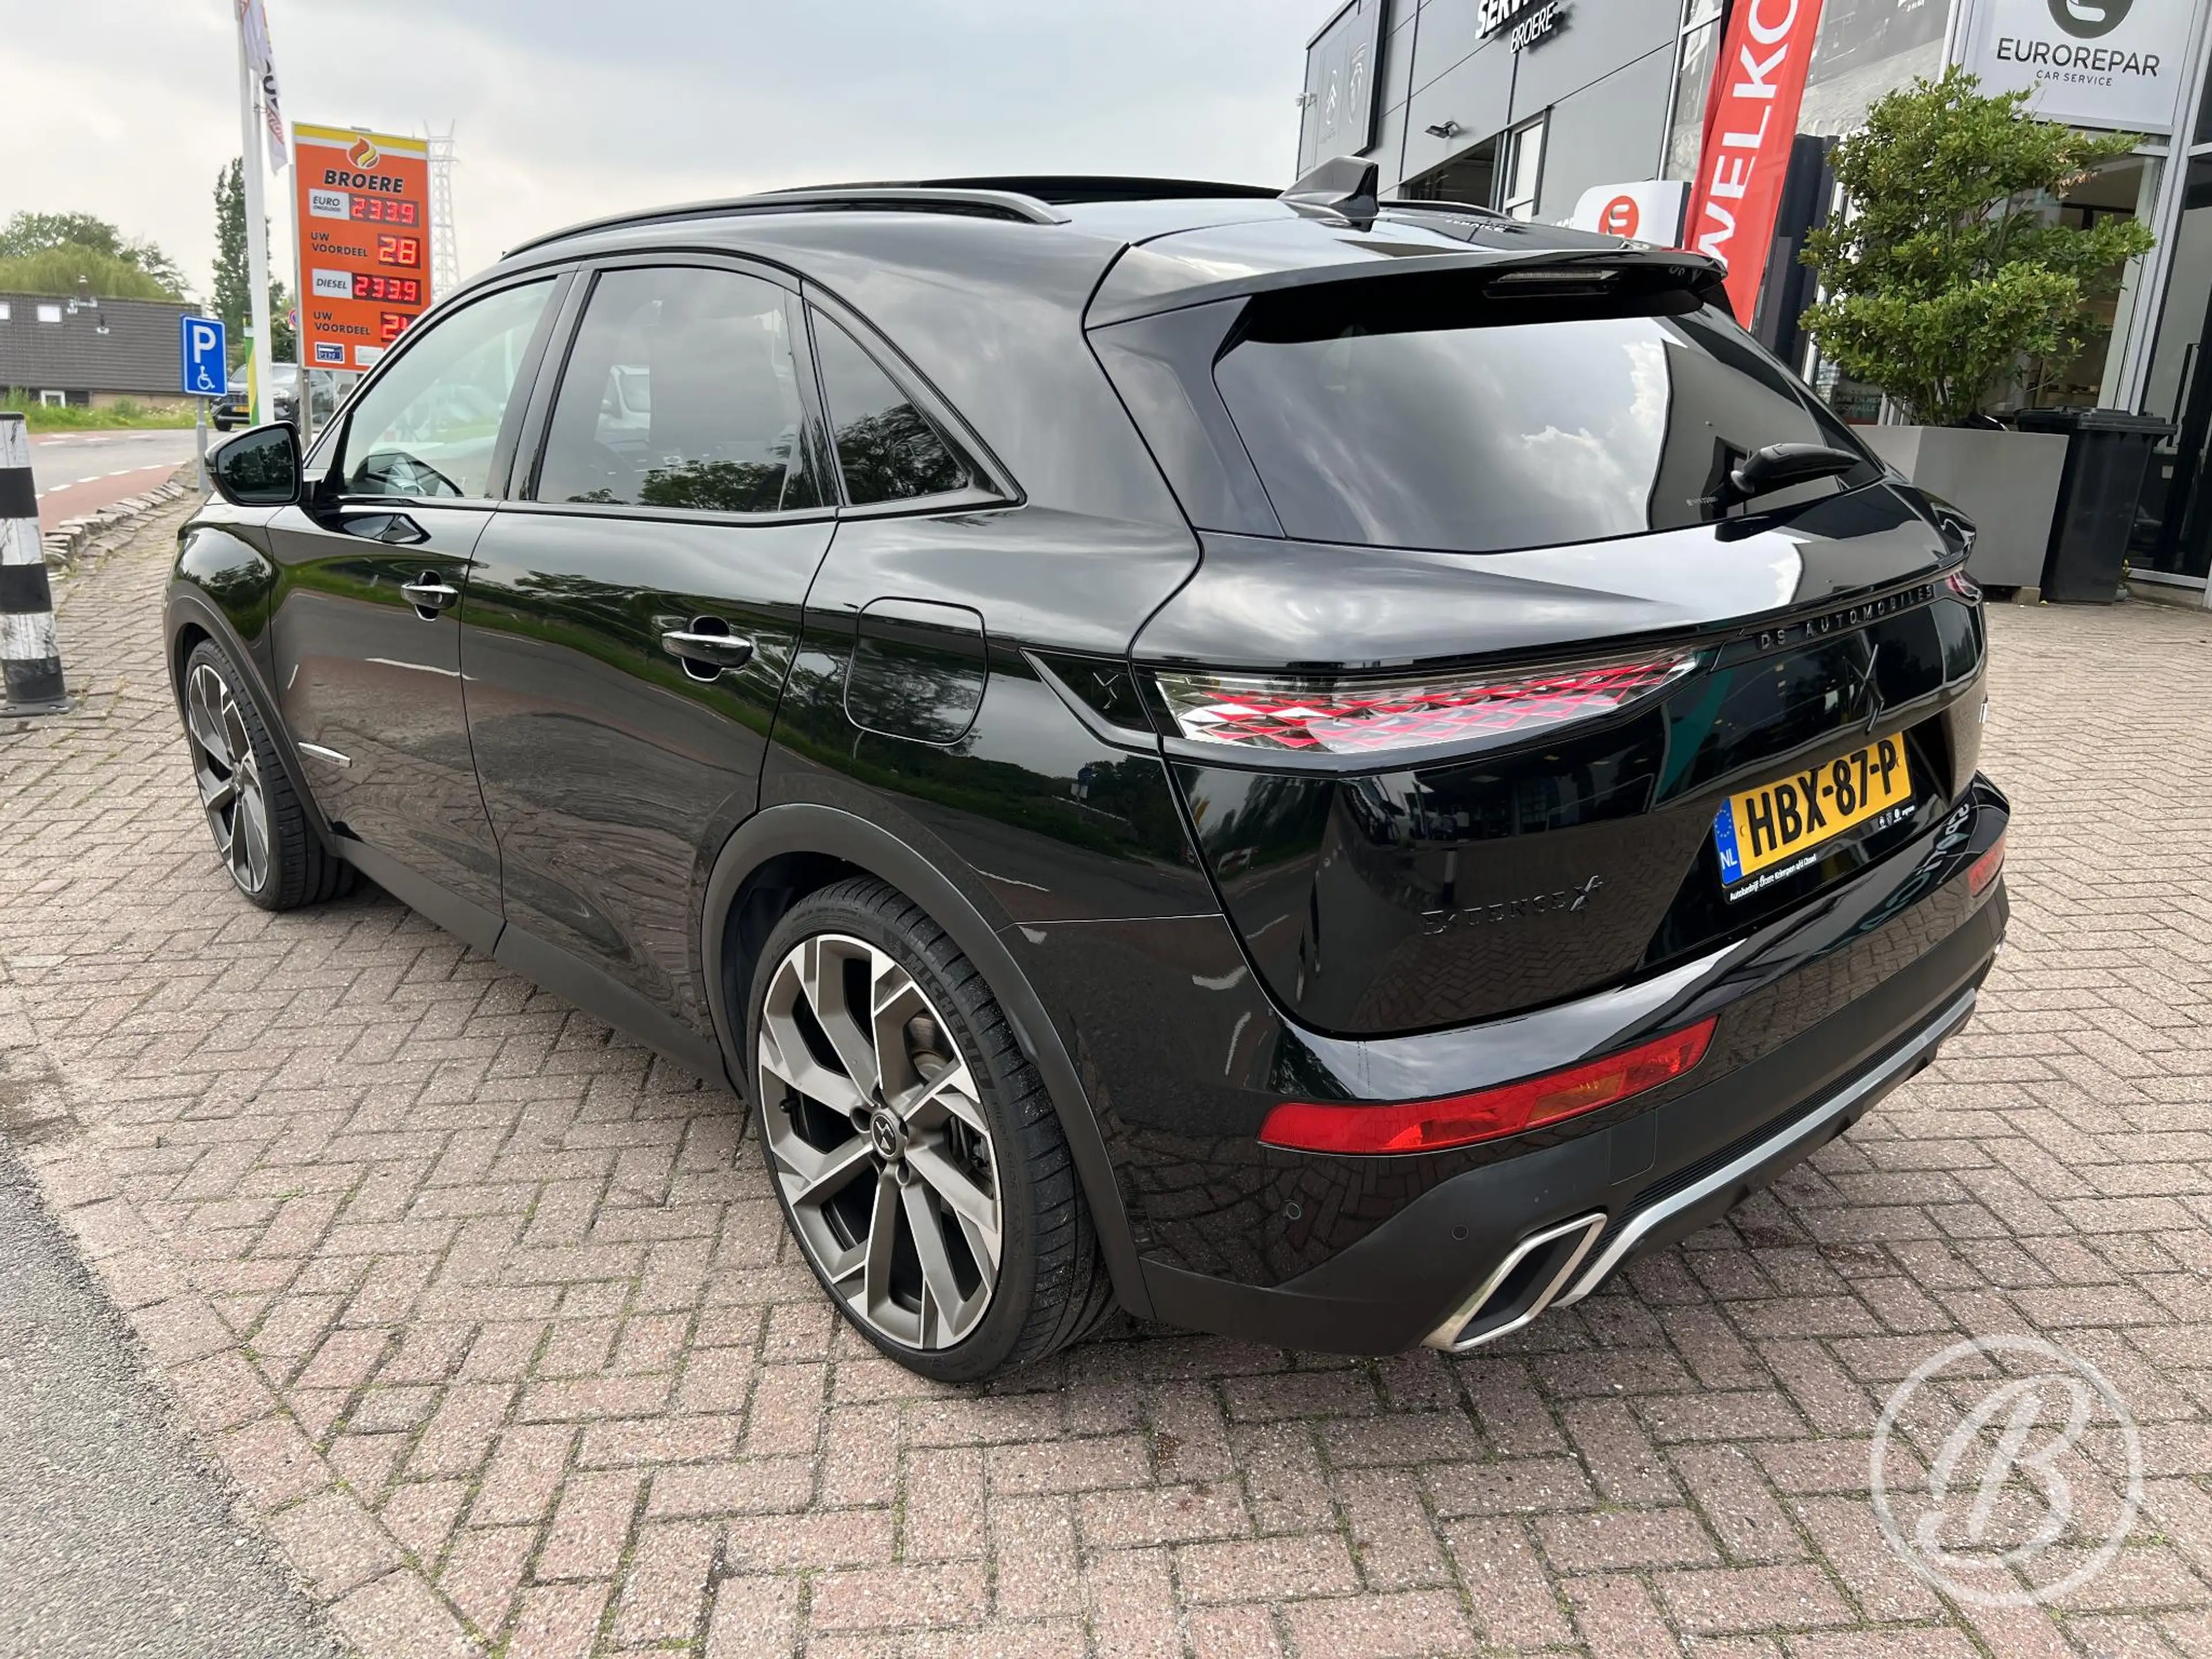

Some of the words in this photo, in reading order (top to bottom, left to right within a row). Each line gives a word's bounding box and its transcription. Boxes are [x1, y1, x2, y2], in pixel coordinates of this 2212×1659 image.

[1510, 2, 1555, 54] BROERE
[1997, 38, 2160, 77] EUROREPAR
[2036, 70, 2059, 81] CAR
[2063, 73, 2112, 86] SERVICE
[324, 169, 403, 194] BROERE
[313, 196, 340, 206] EURO
[311, 232, 329, 241] UW
[312, 243, 368, 257] VOORDEEL
[378, 236, 417, 265] 28
[316, 278, 347, 289] DIESEL
[313, 312, 332, 321] UW
[315, 323, 371, 335] VOORDEEL
[381, 314, 408, 339] 2
[193, 325, 216, 363] P
[1760, 630, 1786, 650] DS
[1805, 584, 1936, 638] AUTOMOBILES
[1745, 740, 1897, 857] HBX-87-P
[1719, 848, 1738, 870] NL
[905, 952, 992, 1083] MICHELIN
